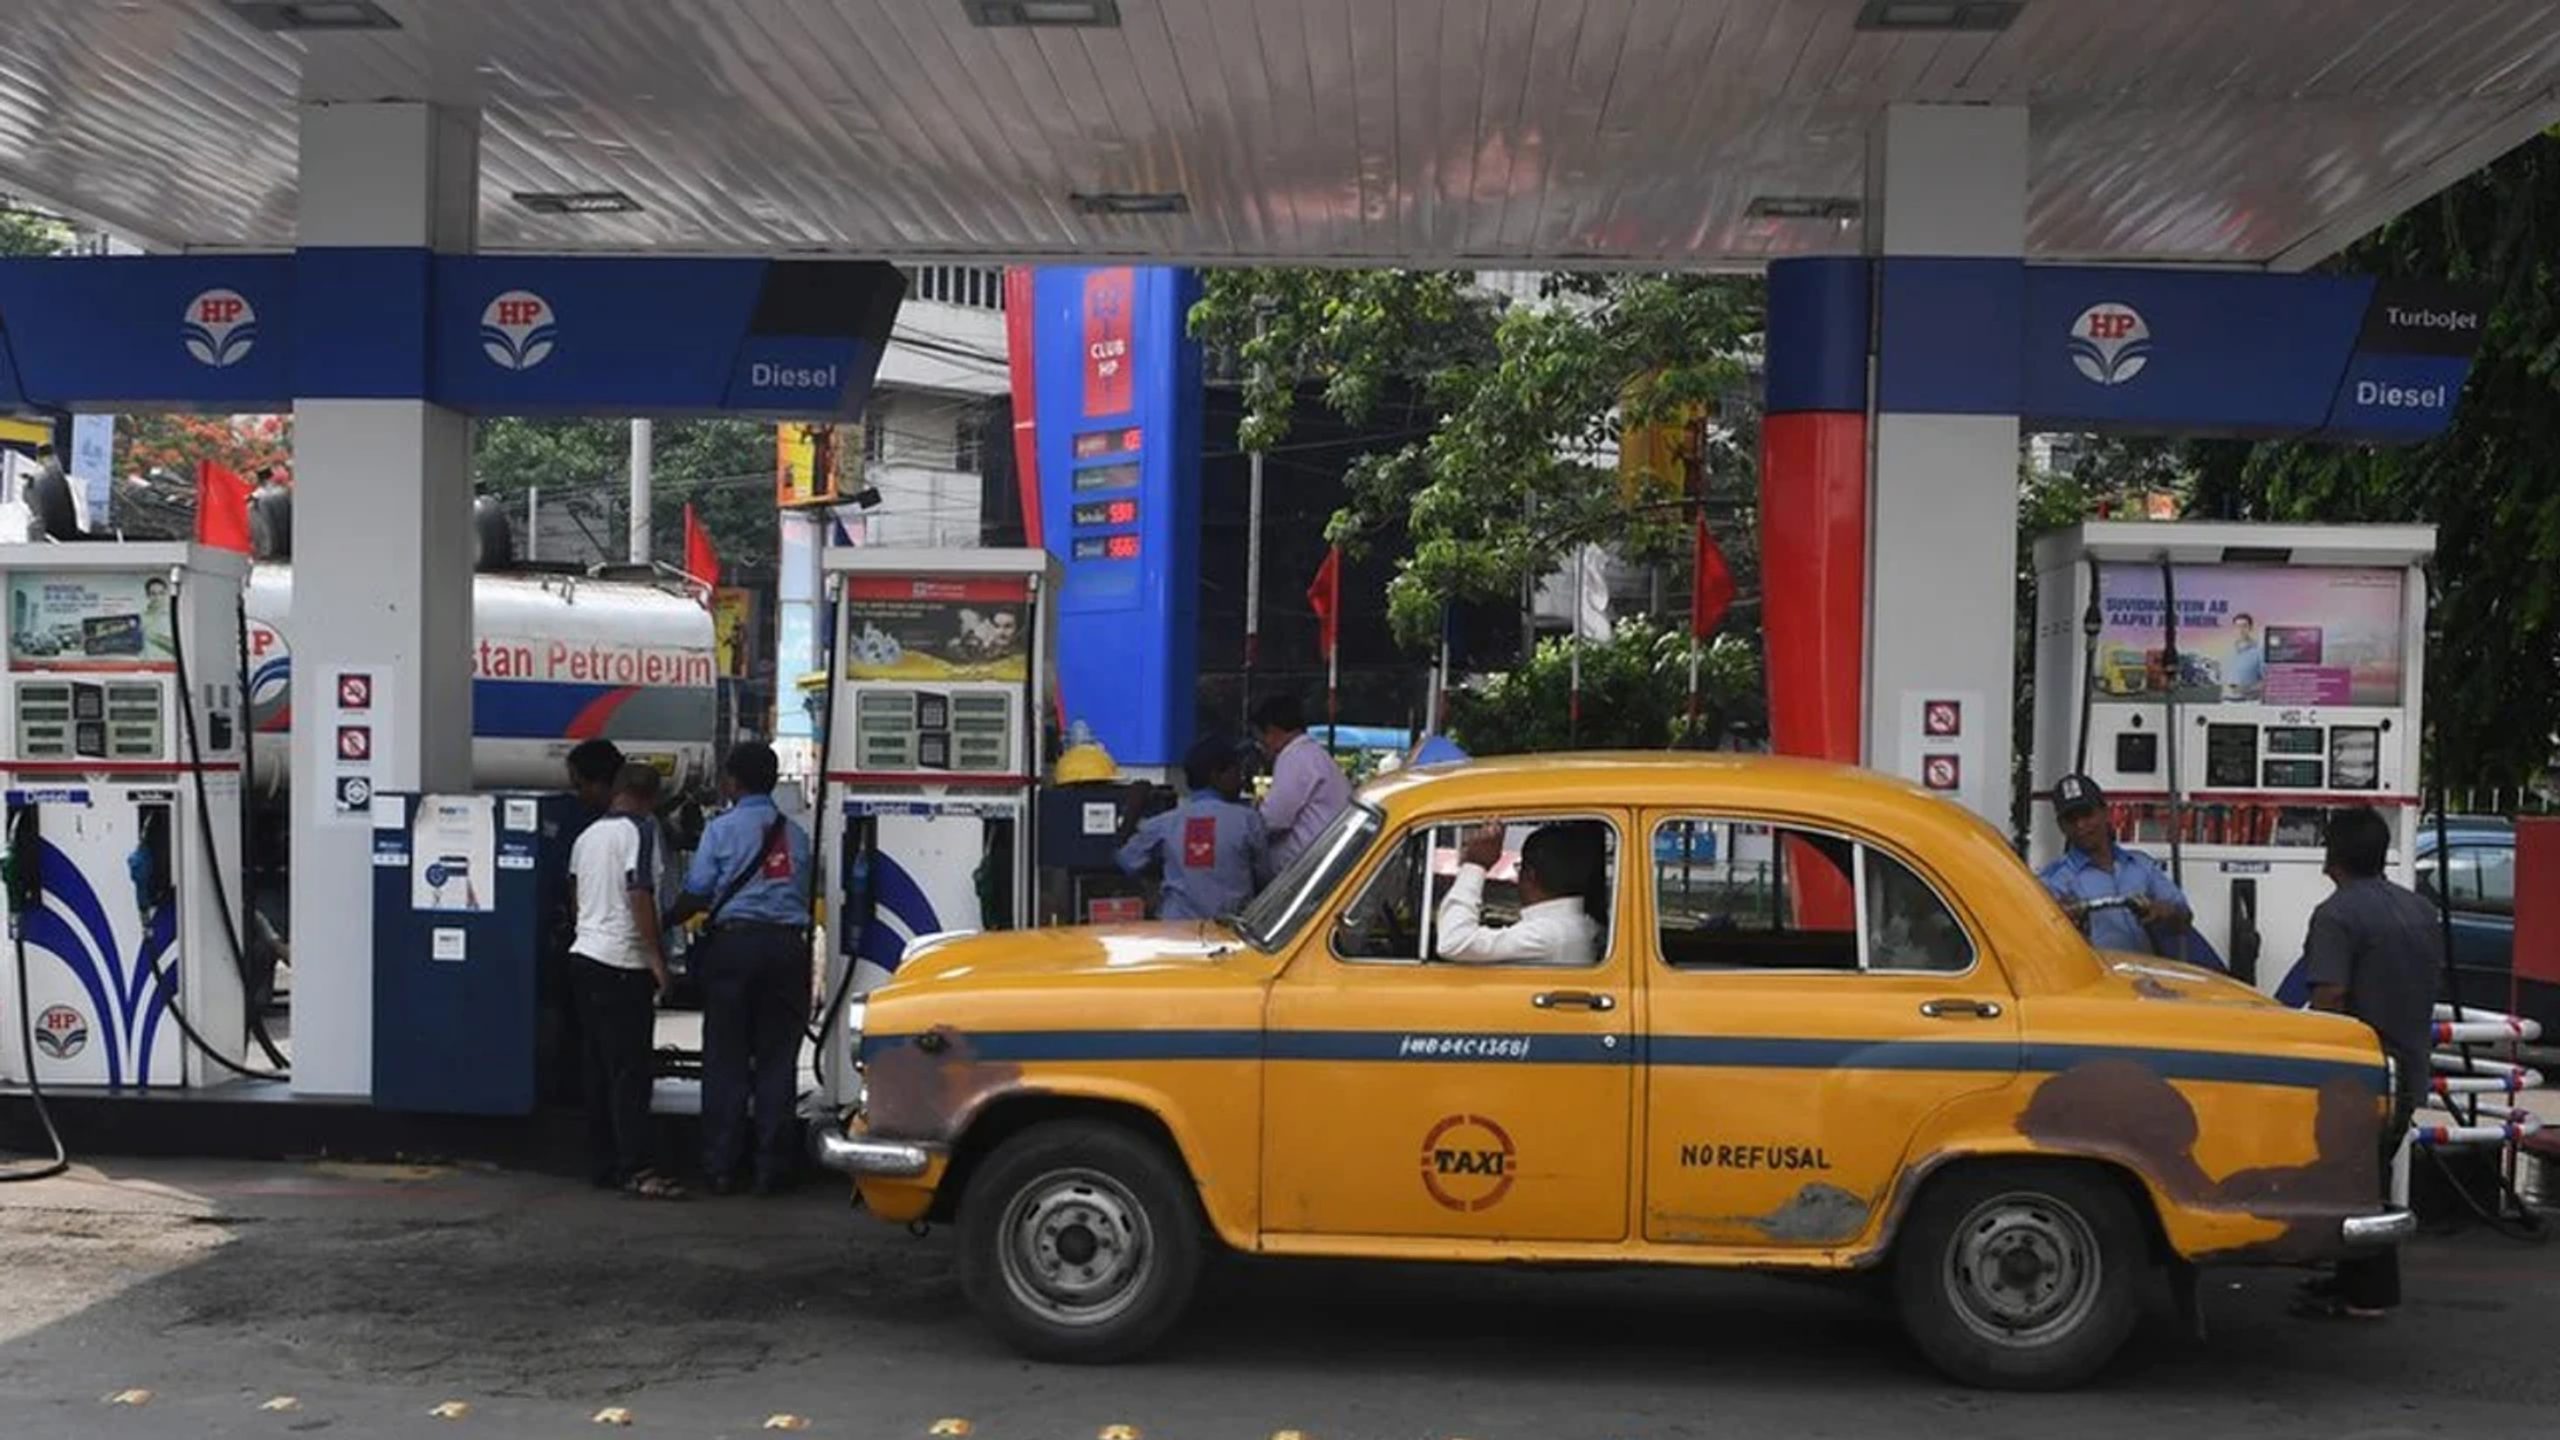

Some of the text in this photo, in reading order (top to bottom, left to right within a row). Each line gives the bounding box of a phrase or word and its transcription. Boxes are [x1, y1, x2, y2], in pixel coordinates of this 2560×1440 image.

[200, 300, 243, 323] HP
[498, 301, 542, 325] HP
[2088, 313, 2136, 339] HP
[1090, 339, 1125, 359] CLUB
[751, 363, 837, 388] Diesel
[2356, 380, 2447, 409] Diesel
[472, 639, 713, 685] tan Petroleum
[47, 1013, 77, 1030] HP
[1434, 1149, 1504, 1176] TAXI
